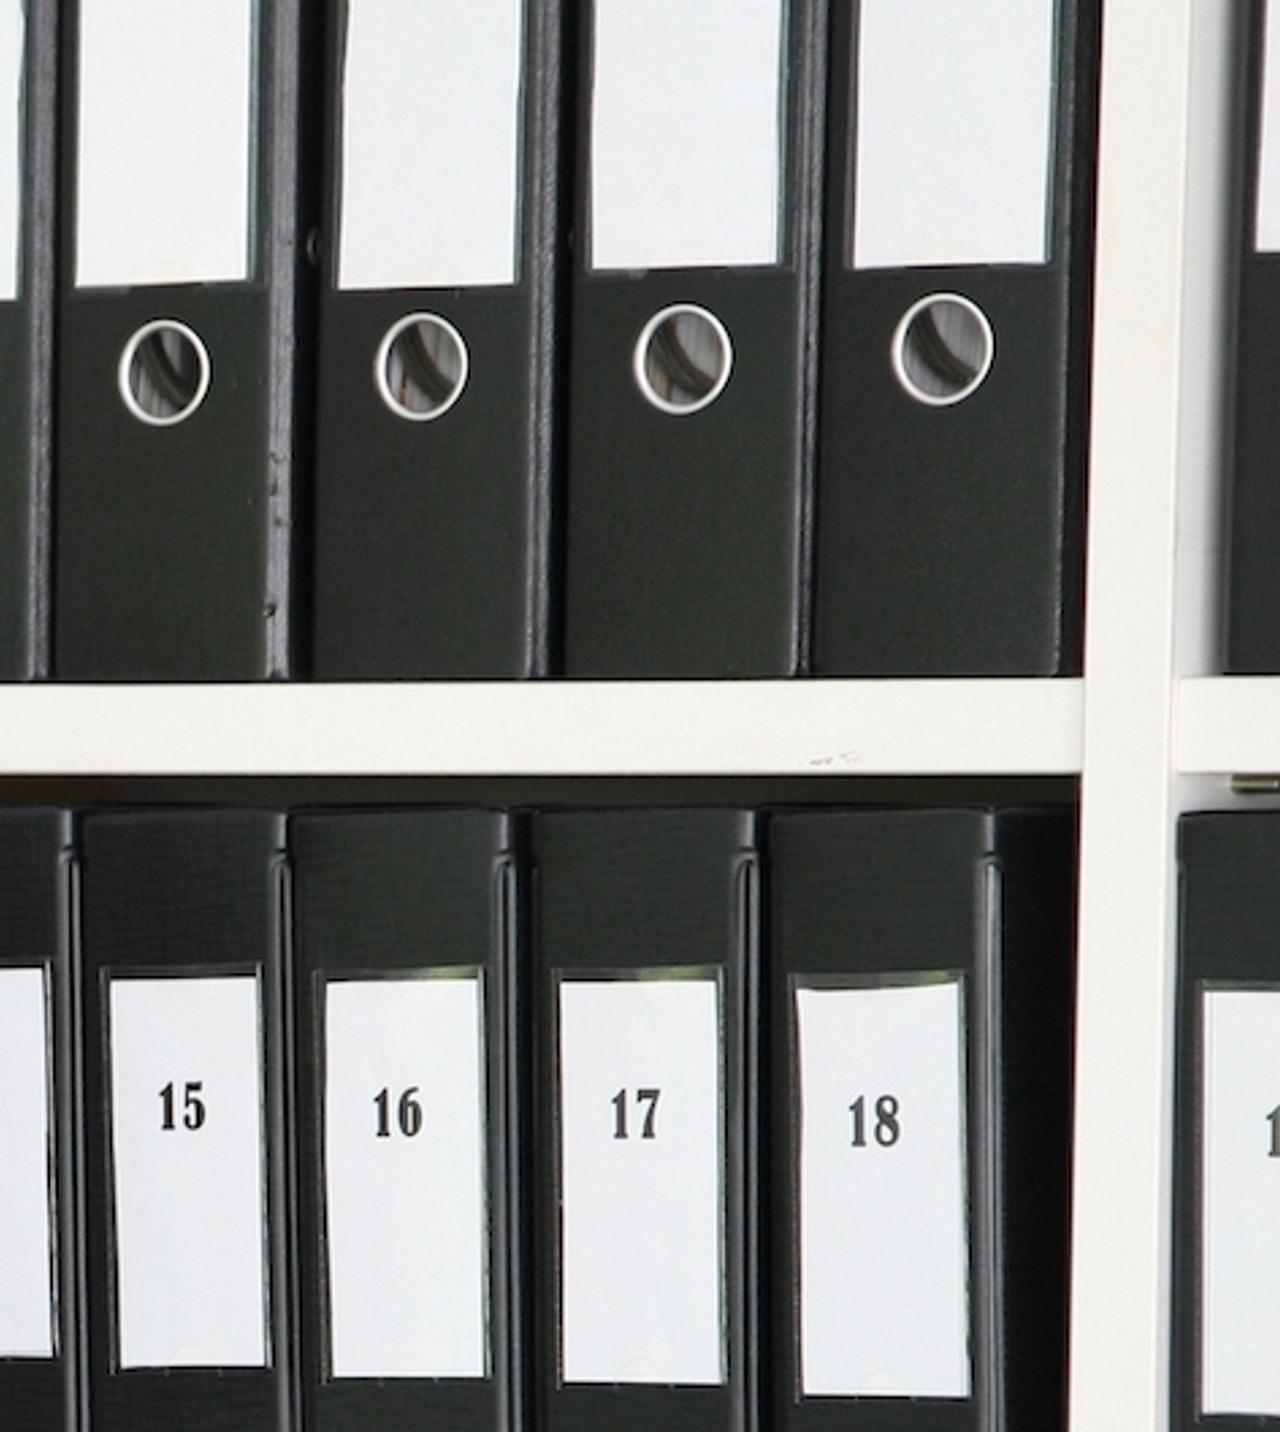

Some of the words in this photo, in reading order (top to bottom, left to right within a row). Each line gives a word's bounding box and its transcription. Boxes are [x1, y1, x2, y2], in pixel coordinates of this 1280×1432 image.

[158, 1081, 206, 1132] 15
[373, 1086, 423, 1138] 16
[611, 1088, 661, 1140] 17
[848, 1094, 901, 1148] 18
